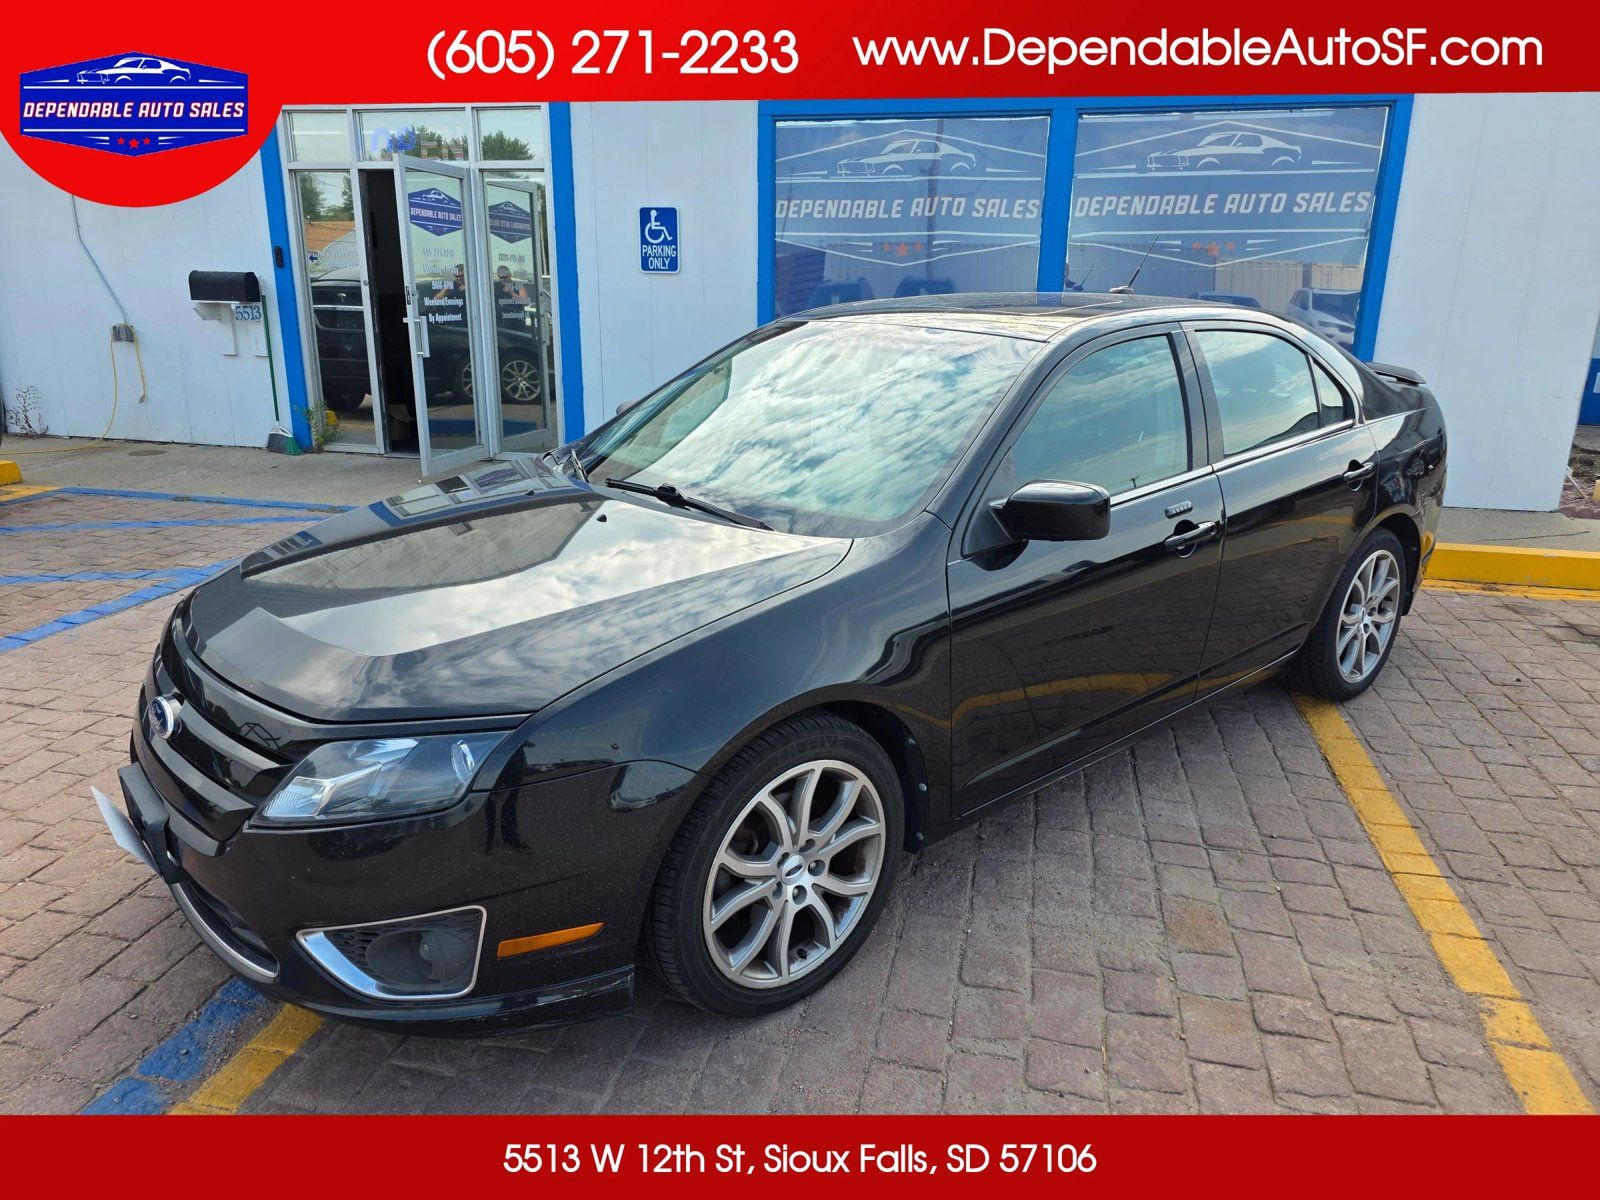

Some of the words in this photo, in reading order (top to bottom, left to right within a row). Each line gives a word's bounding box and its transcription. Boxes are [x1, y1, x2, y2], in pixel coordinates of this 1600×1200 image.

[775, 199, 904, 219] DEPENDABLE
[909, 196, 967, 217] AUTO
[971, 198, 1041, 219] SALES
[1074, 193, 1218, 217] DEPENDABLE
[1223, 193, 1287, 214] AUTO
[1292, 191, 1371, 213] SALES
[642, 244, 677, 258] PARKING
[648, 257, 671, 270] ONLY
[235, 304, 262, 321] 5513
